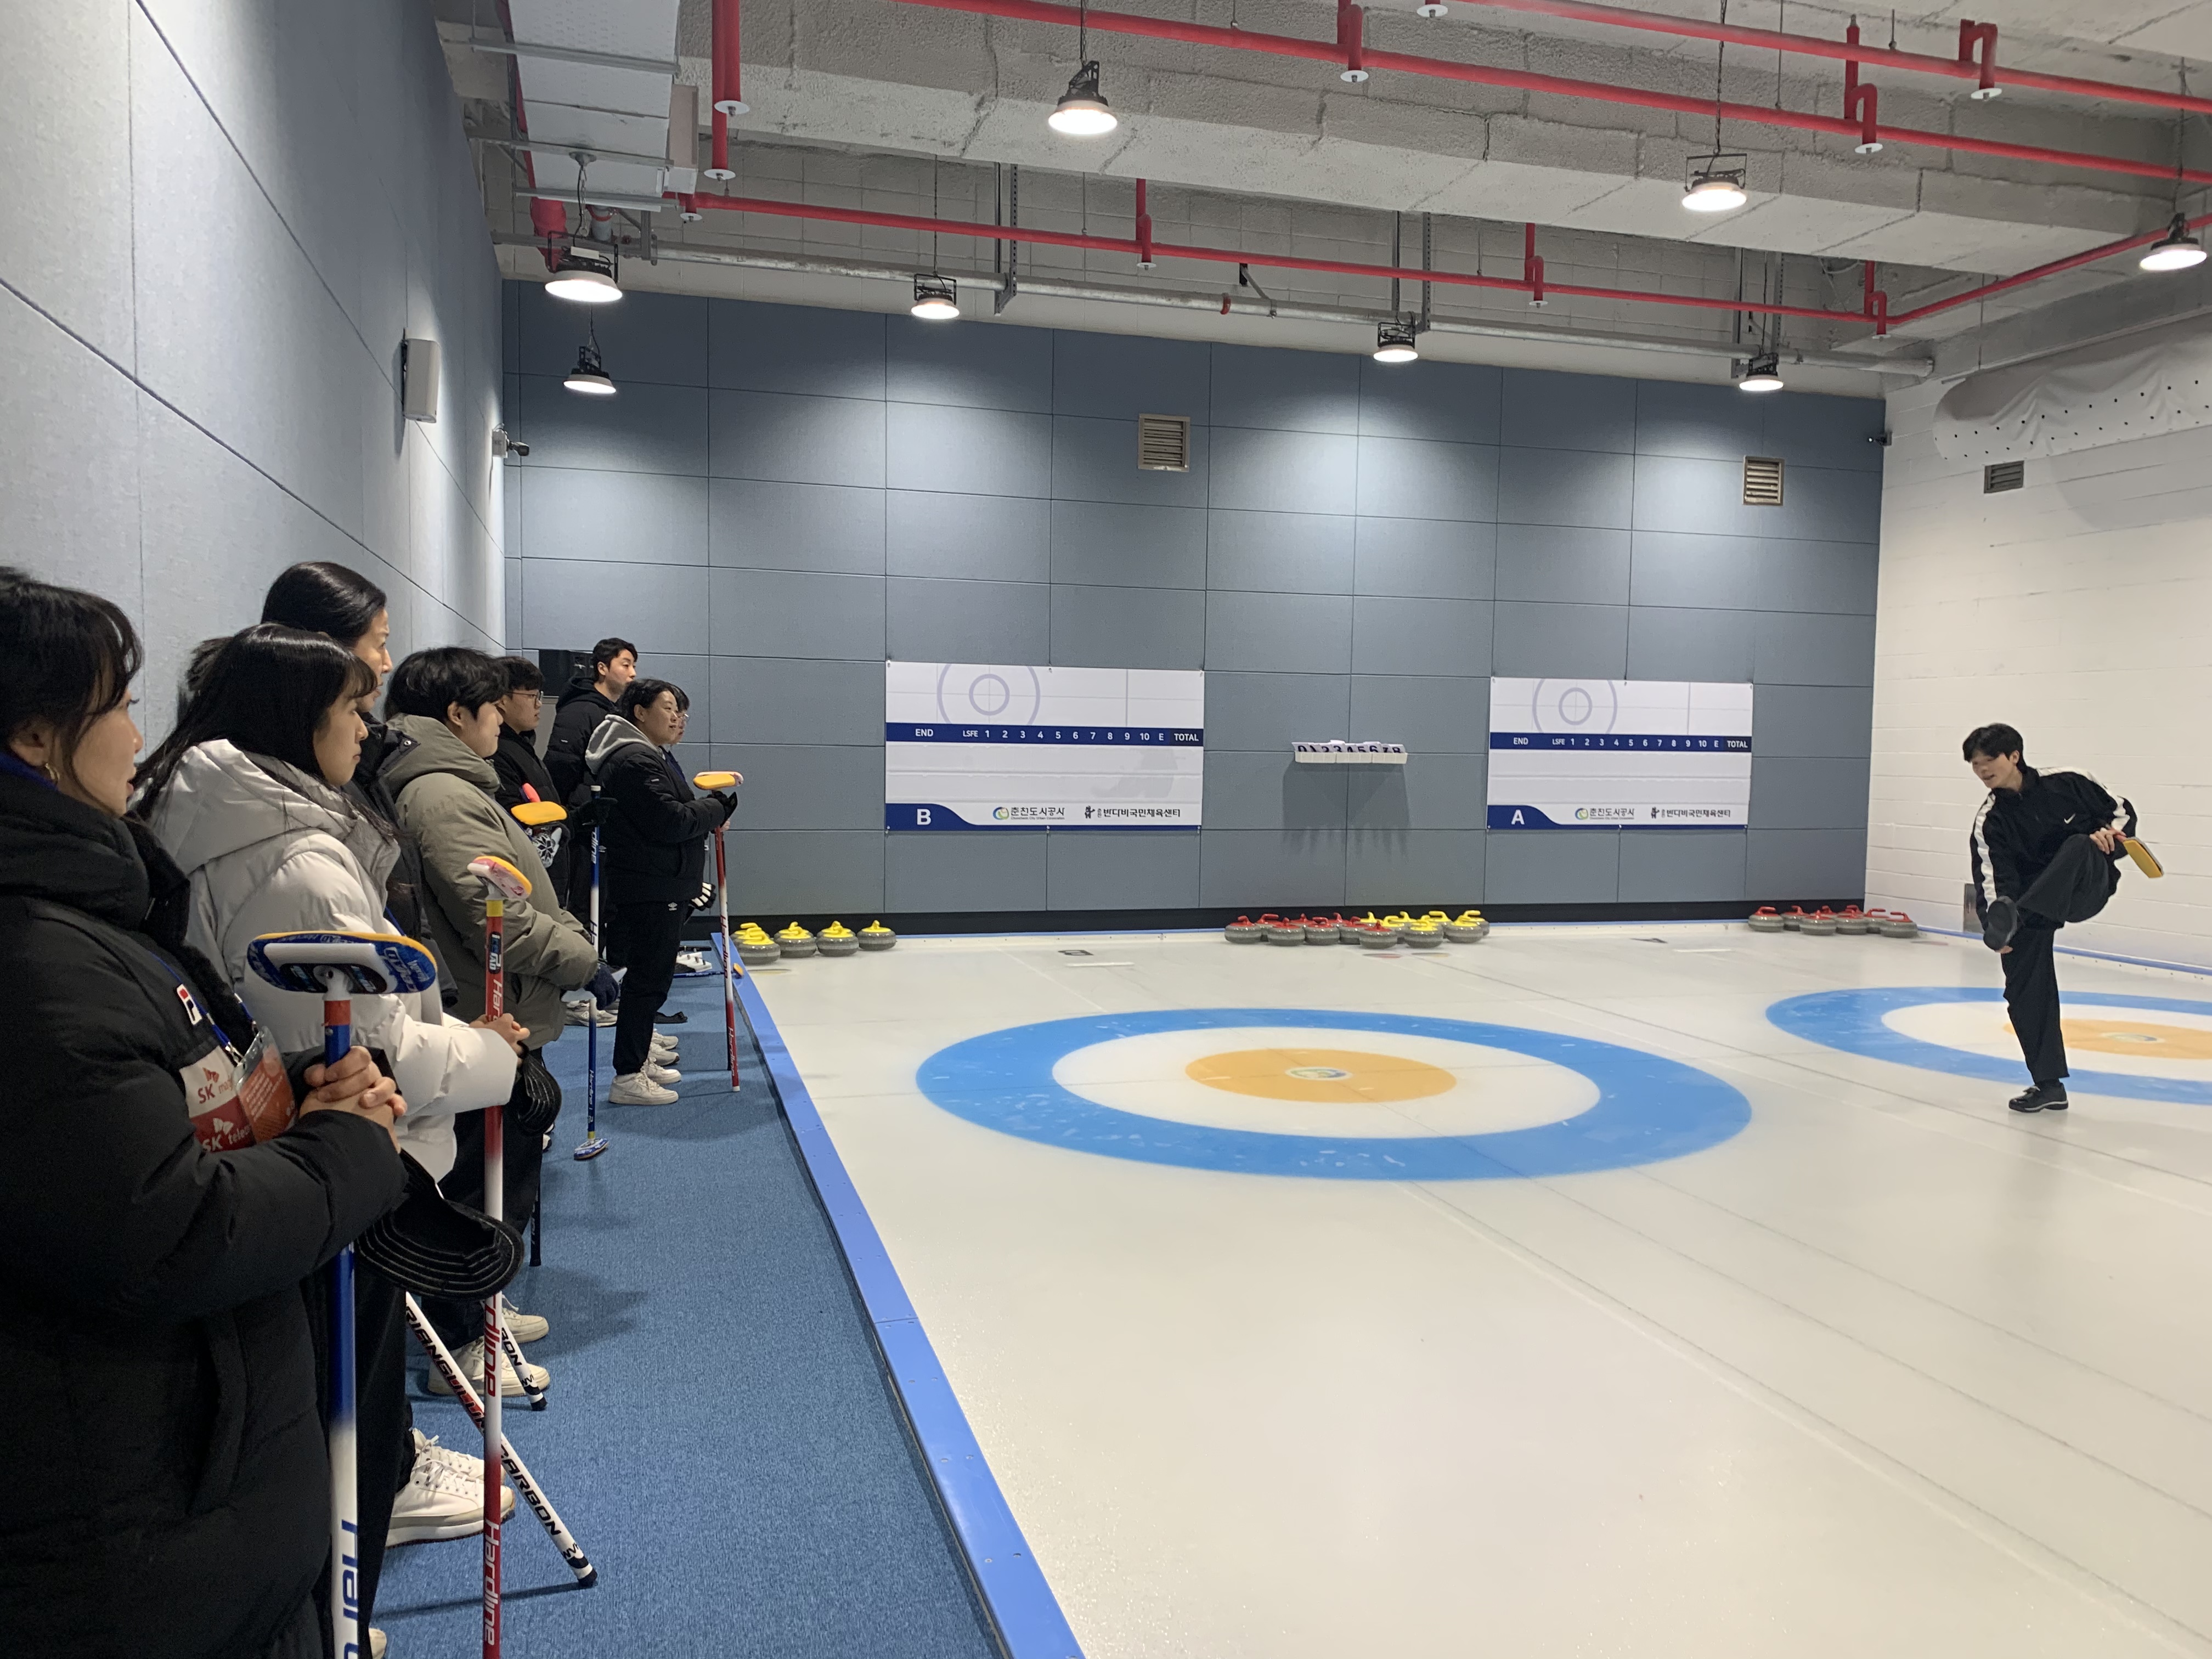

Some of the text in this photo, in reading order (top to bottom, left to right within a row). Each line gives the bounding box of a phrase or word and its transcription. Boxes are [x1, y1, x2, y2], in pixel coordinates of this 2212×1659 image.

[915, 728, 934, 737] END
[985, 730, 990, 738] 1
[1002, 730, 1008, 738] 2
[1020, 730, 1026, 738] 3
[1037, 731, 1044, 739] 4
[1055, 731, 1061, 739] 5
[1073, 731, 1079, 740] 6
[1090, 731, 1096, 740] 7
[1107, 732, 1113, 740] 8
[1139, 732, 1150, 741] 10
[1173, 733, 1199, 741] TOTAL
[1513, 737, 1528, 745] END
[1584, 738, 1590, 746] 2
[1628, 738, 1634, 747] 5
[1671, 739, 1677, 747] 8
[1698, 740, 1707, 748] 10
[1726, 740, 1748, 748] TOTAL
[917, 809, 932, 825] B
[1011, 807, 1065, 816] 춘천도시공사
[1103, 808, 1181, 817] 반다비국민체육센터
[1511, 809, 1525, 825] A
[198, 1084, 215, 1104] SK
[202, 1133, 223, 1152] SK
[485, 1518, 499, 1645] Hardline
